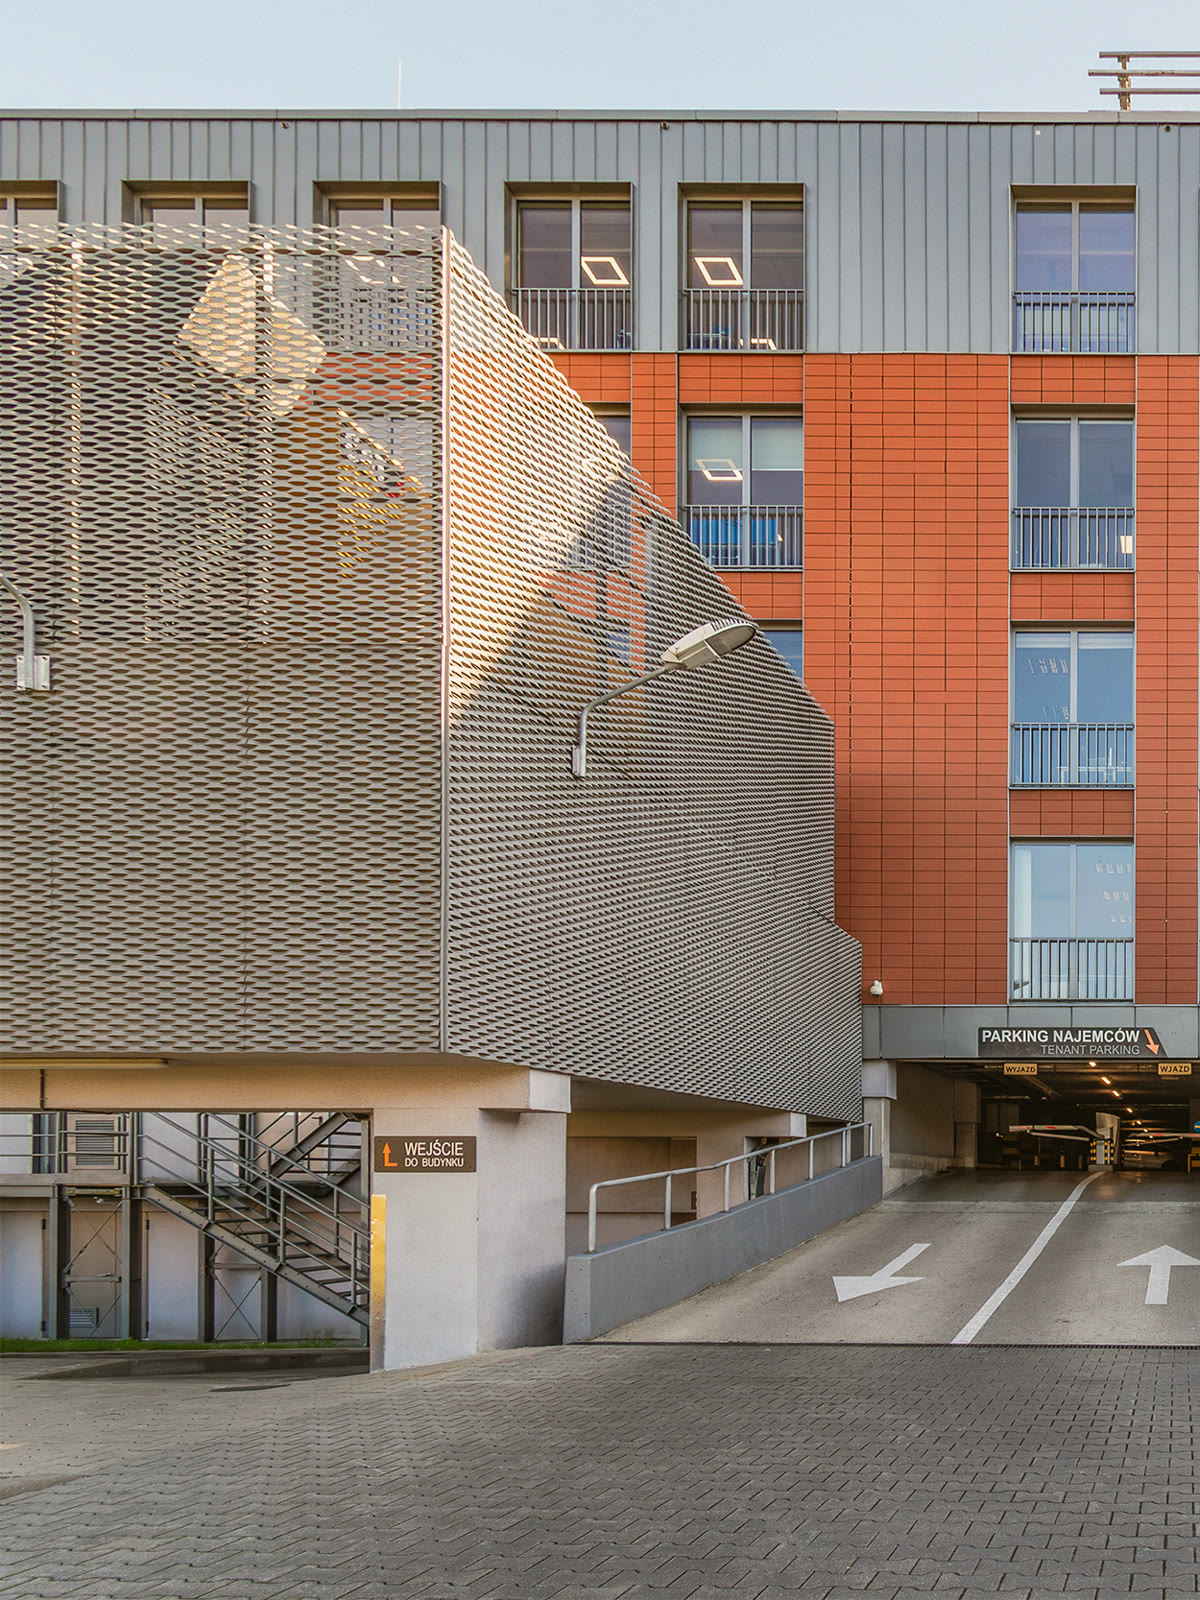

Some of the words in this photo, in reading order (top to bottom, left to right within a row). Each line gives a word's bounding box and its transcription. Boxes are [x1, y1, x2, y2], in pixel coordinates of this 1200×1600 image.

[982, 1030, 1049, 1043] PARKING
[1053, 1027, 1140, 1043] NAJEMCÓW
[1040, 1044, 1087, 1055] TENANT
[1089, 1044, 1140, 1055] PARKING
[404, 1139, 464, 1156] WEJŚCIE
[404, 1157, 418, 1167] DO
[422, 1157, 464, 1167] BUDYNKU
